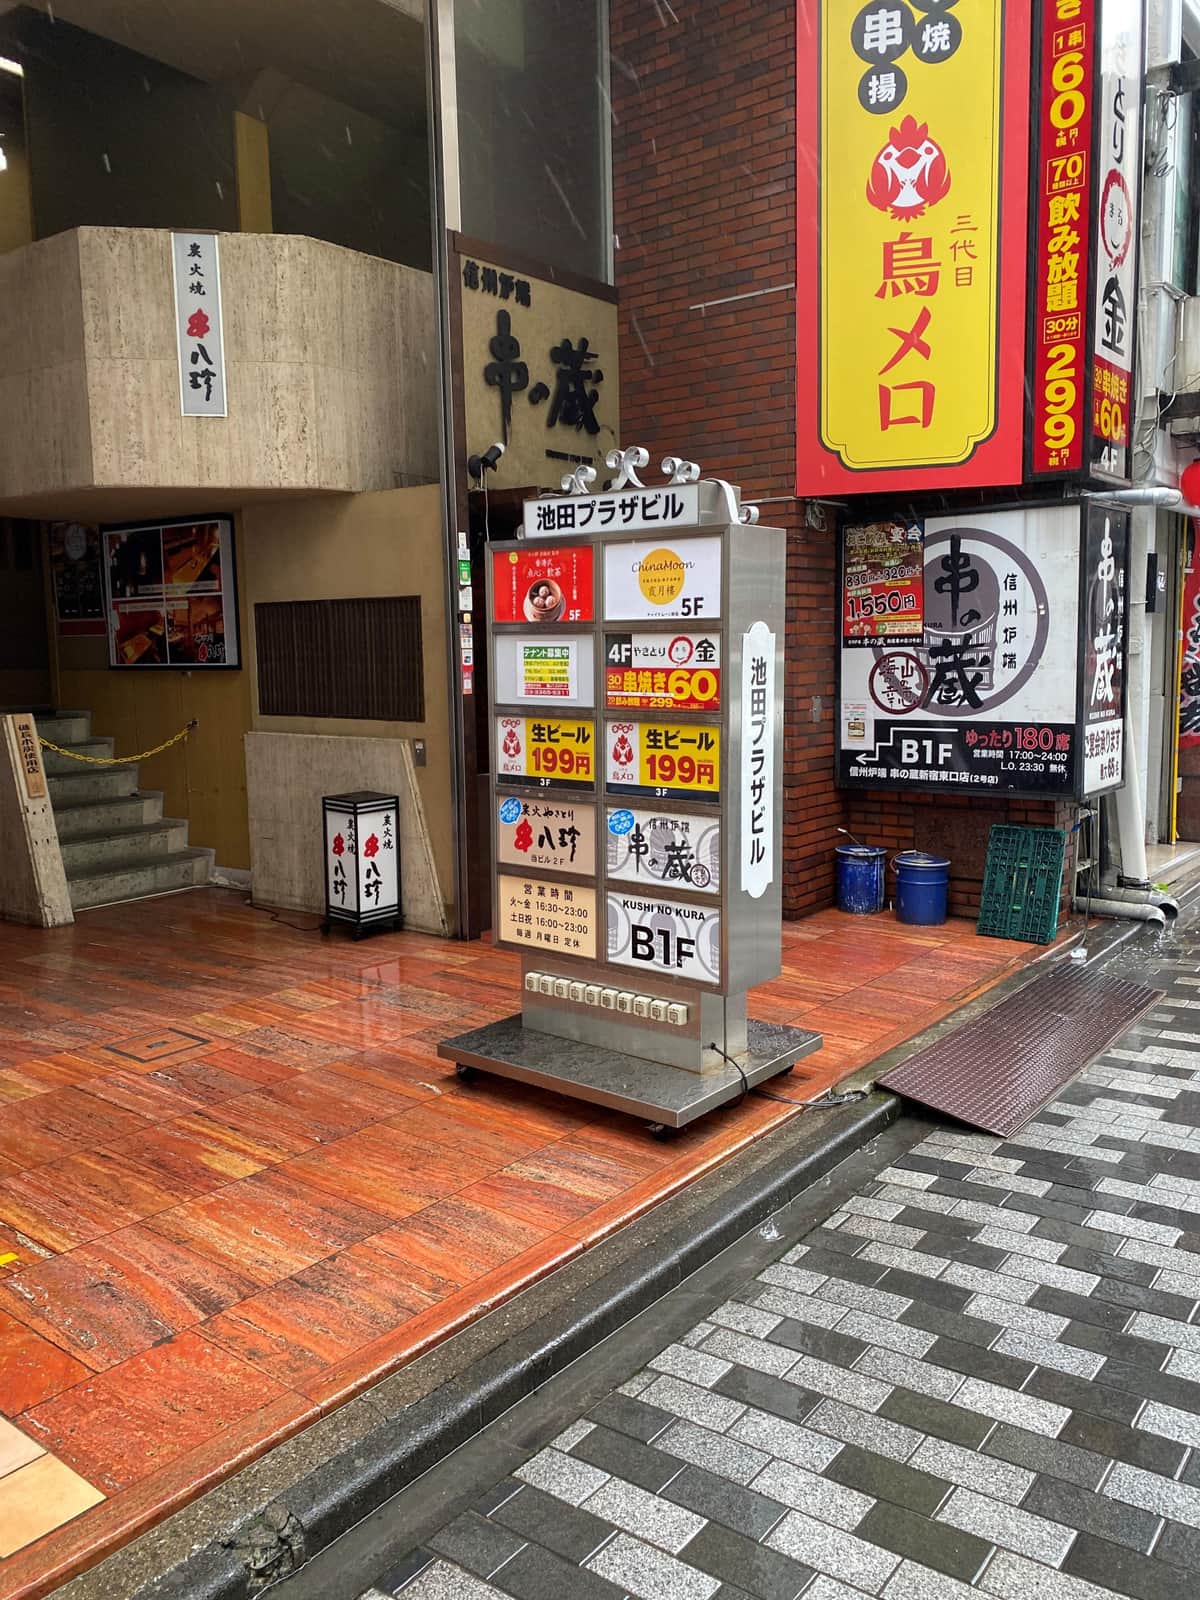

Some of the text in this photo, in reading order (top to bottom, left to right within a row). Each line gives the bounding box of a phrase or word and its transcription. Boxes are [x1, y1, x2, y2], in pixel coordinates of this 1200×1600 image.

[1050, 52, 1086, 129] 60
[1051, 155, 1083, 182] 70
[949, 214, 979, 288] 三代目
[1046, 192, 1081, 312] 飲み放題
[186, 241, 207, 297] 炭火焼
[1045, 317, 1079, 335] 30分
[1102, 274, 1128, 357] 金
[873, 231, 942, 432] 鳥メロ
[1043, 343, 1077, 449] 299
[1100, 398, 1122, 441] 60
[1100, 445, 1119, 473] 4F
[537, 493, 684, 531] 池田プラザビル
[569, 609, 581, 621] 5F
[681, 597, 704, 617] 5F
[1002, 572, 1018, 670] 信州炉端
[609, 643, 632, 663] 4F
[695, 638, 716, 663] 金
[608, 674, 622, 685] 30
[623, 670, 667, 694] 串焼き
[668, 669, 718, 701] 60
[649, 697, 674, 708] 299
[532, 723, 591, 744] 生ビール
[645, 728, 715, 752] 生ビール
[531, 746, 591, 775] 199円
[750, 656, 767, 866] 池田プラザビル
[901, 738, 953, 766] B1F
[539, 777, 551, 787] 3F
[645, 753, 715, 785] 199円
[655, 787, 668, 797] 3F
[523, 883, 574, 903] 営業時間
[510, 911, 533, 925] 土日祝
[622, 899, 706, 920] KUSHI NO KURA
[536, 931, 559, 945] 月曜日
[631, 923, 696, 969] B1F
